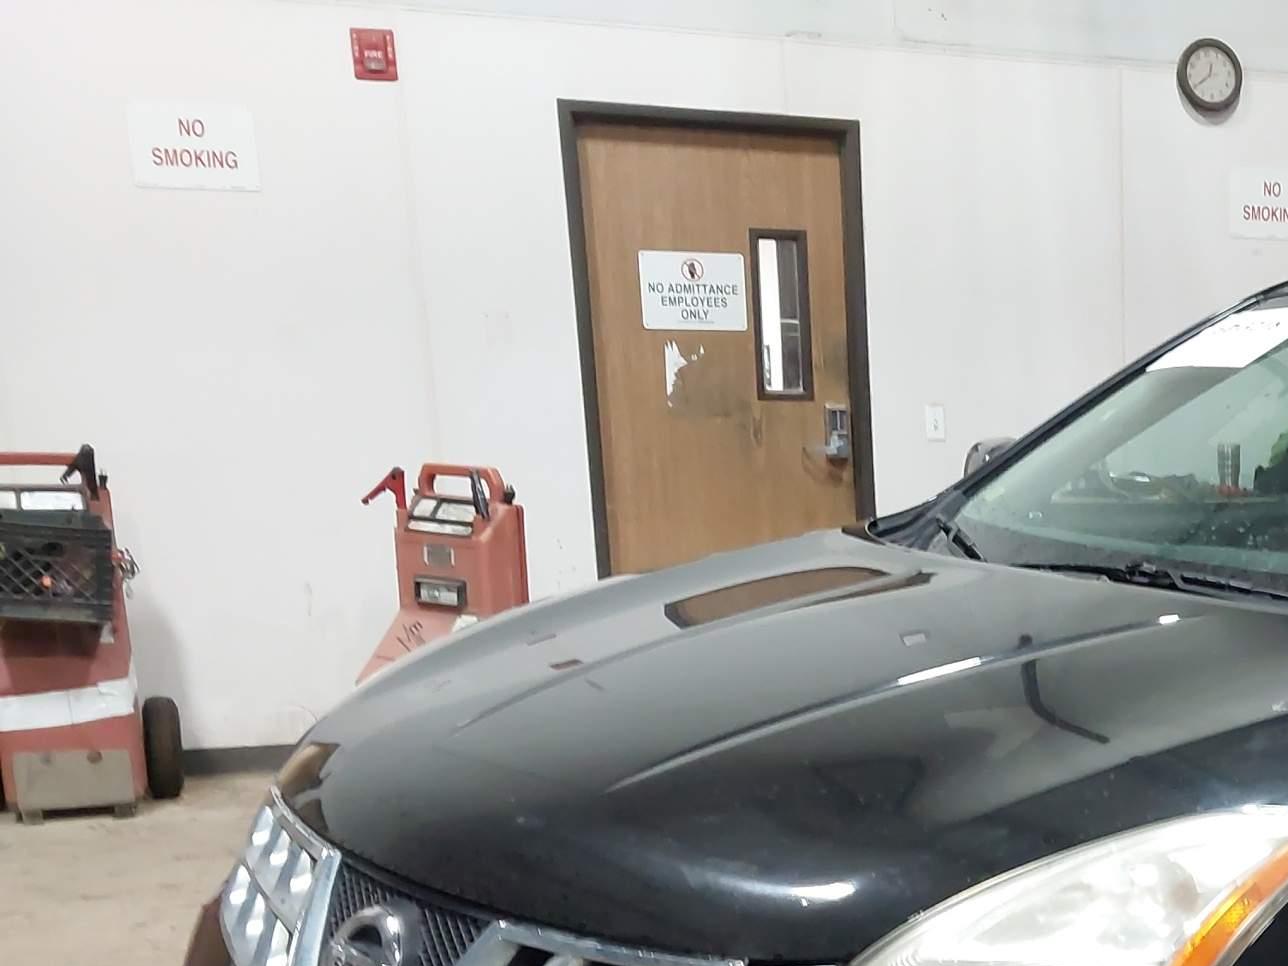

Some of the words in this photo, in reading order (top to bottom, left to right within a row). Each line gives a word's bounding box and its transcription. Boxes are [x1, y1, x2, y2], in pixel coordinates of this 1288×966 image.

[178, 118, 205, 138] NO
[151, 147, 239, 170] SMOKING
[1263, 181, 1282, 198] NO
[648, 282, 664, 294] NO
[668, 283, 739, 296] ADMITTANCE
[661, 296, 728, 309] EMPLOYEES
[681, 308, 710, 321] ONLY
